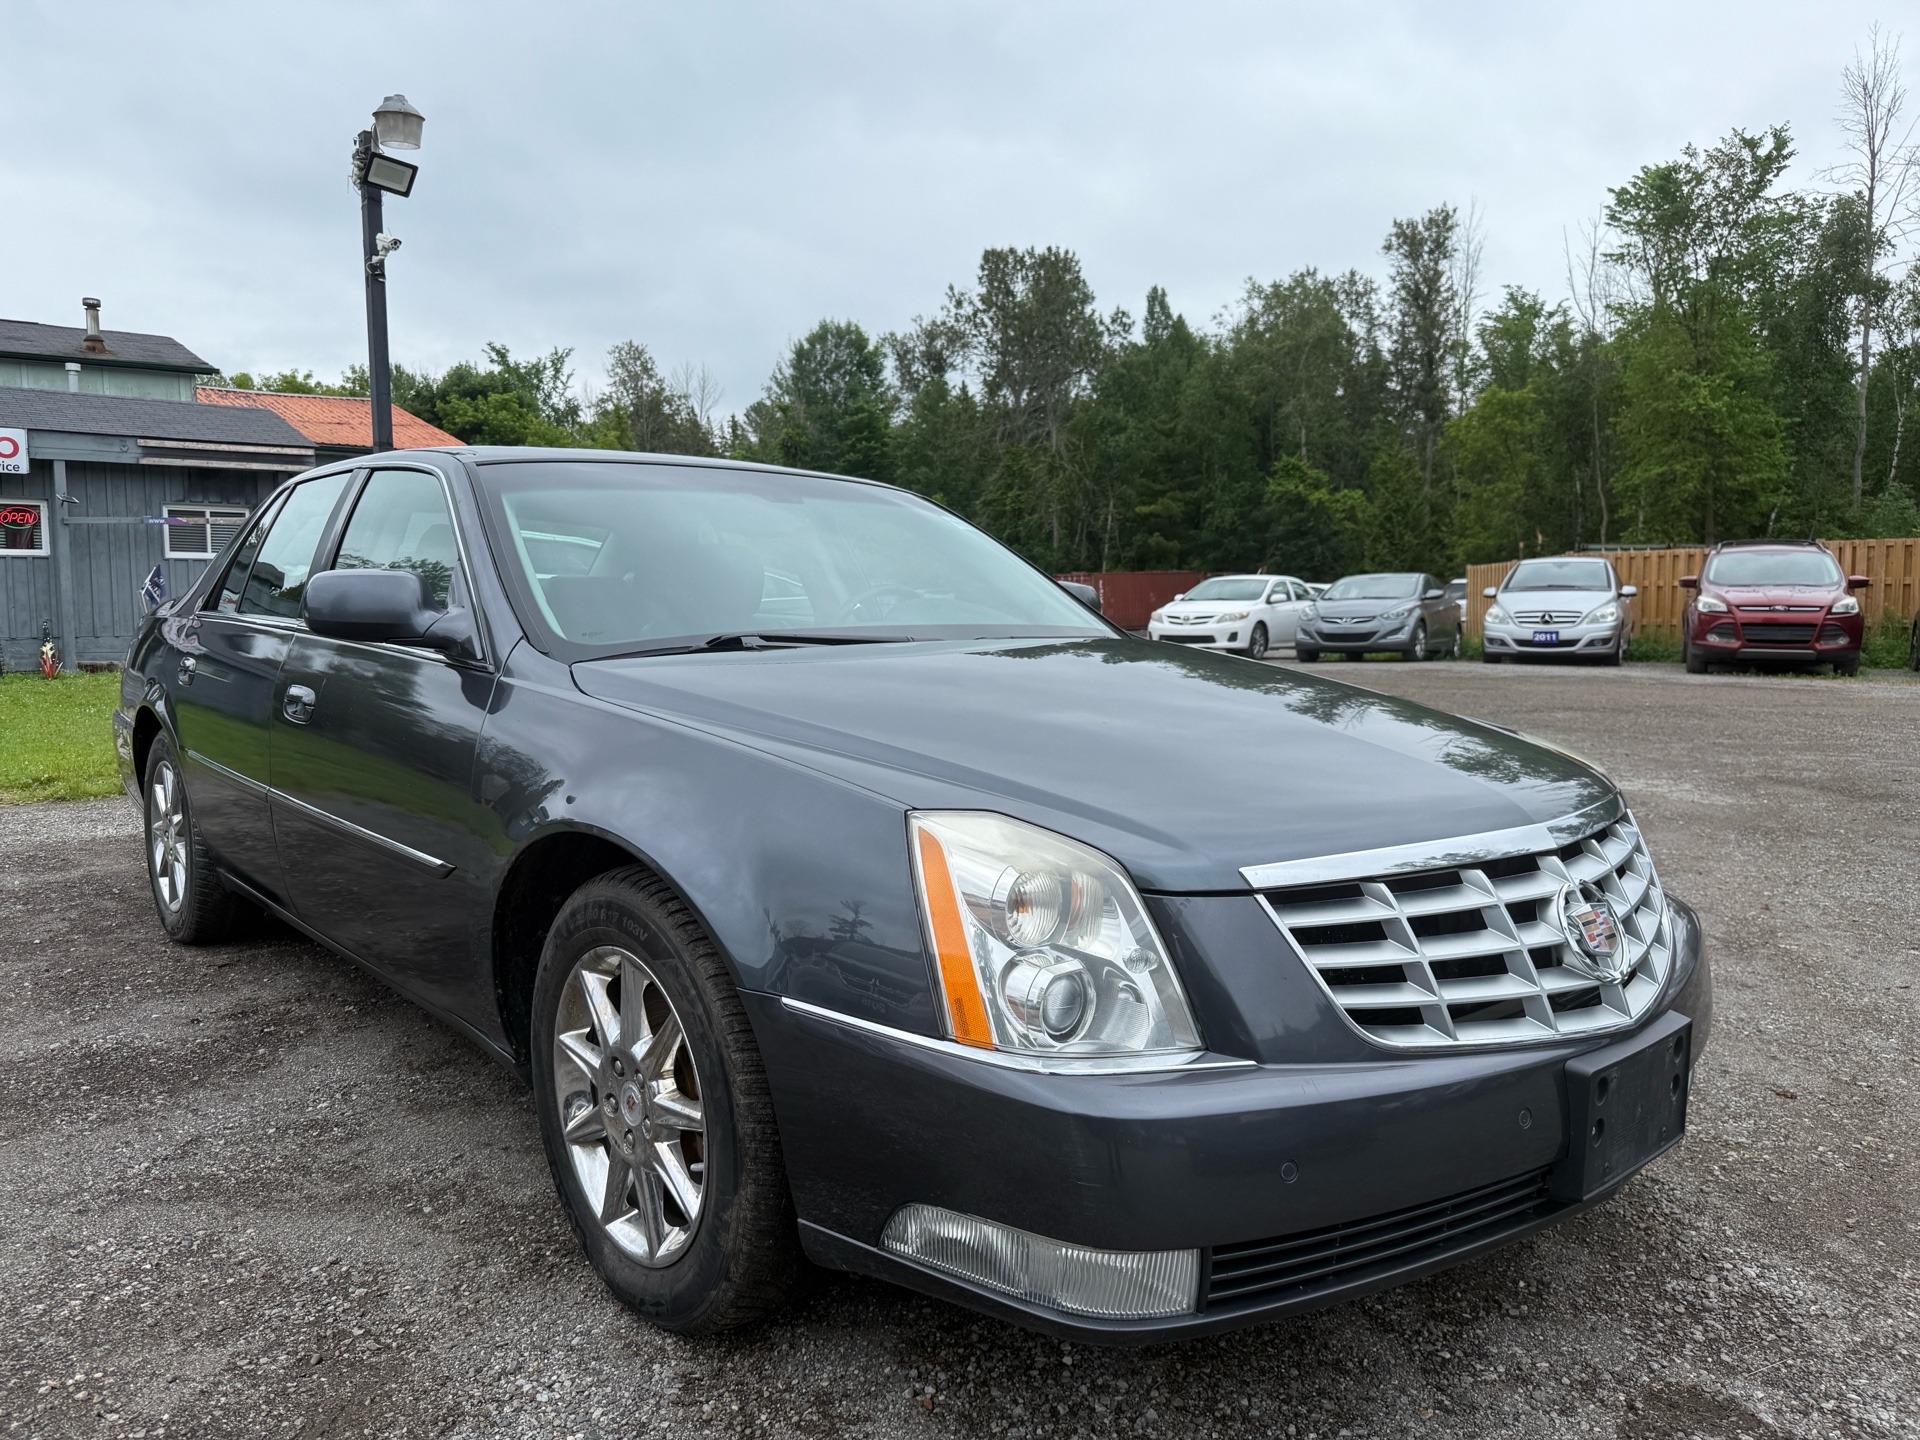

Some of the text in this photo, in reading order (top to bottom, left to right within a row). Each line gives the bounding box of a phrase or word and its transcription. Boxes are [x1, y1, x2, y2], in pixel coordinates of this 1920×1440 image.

[0, 460, 20, 471] ice
[1, 512, 34, 523] OPEN
[1534, 633, 1557, 641] 2011
[622, 916, 649, 941] 103V
